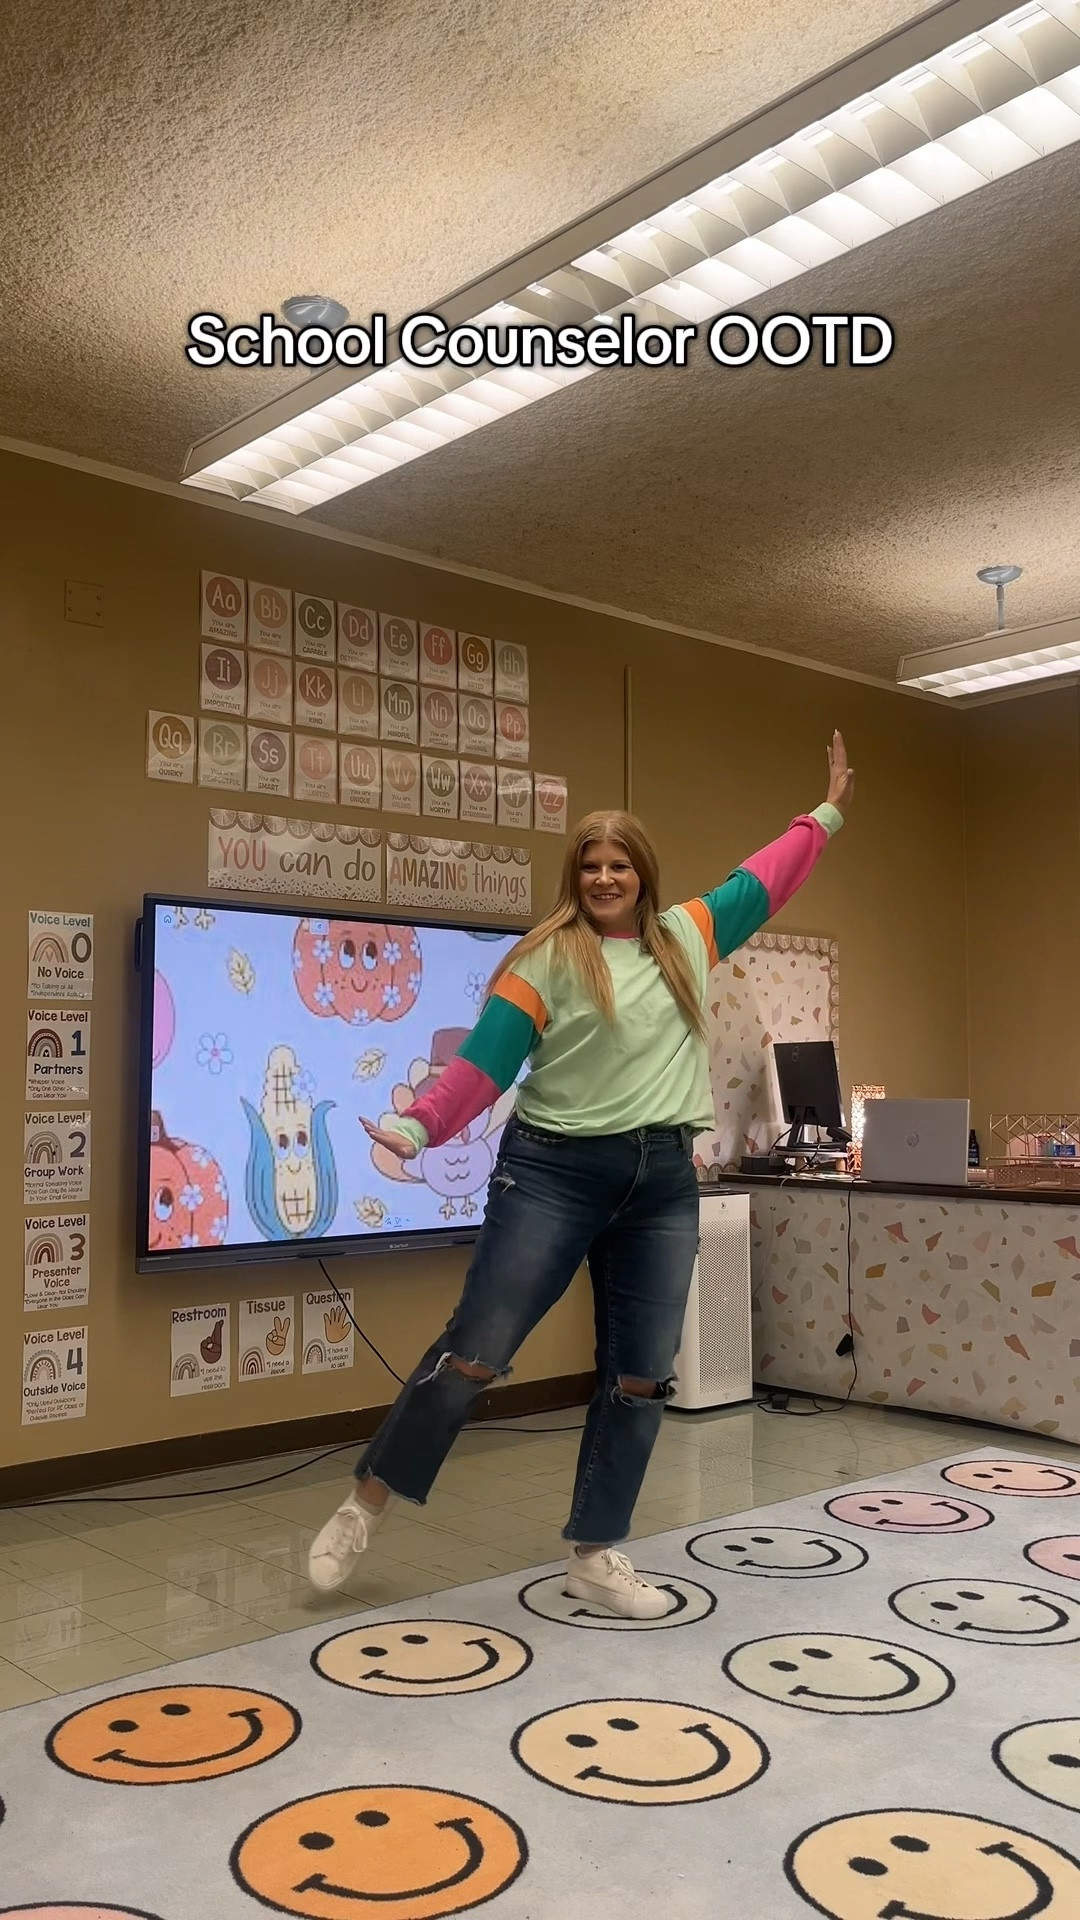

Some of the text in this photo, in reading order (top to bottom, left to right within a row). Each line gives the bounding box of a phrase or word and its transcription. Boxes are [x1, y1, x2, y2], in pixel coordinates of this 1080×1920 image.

[212, 584, 235, 611] Aa
[260, 595, 281, 621] Bb
[305, 605, 325, 630] Cc
[349, 615, 369, 641] Dd
[209, 627, 238, 637] AMAZING
[390, 625, 407, 649] Ee
[302, 647, 328, 657] CAPABLE
[431, 634, 445, 658] Ff
[467, 643, 483, 671] Gg
[216, 656, 231, 682] Ii
[503, 651, 520, 675] Hh
[261, 665, 279, 697] Jj
[306, 674, 326, 699] Kk
[205, 699, 240, 710] IMPORTANT
[387, 690, 410, 716] Mm
[430, 699, 448, 722] Nn
[308, 717, 323, 725] KIND
[468, 705, 484, 728] Oo
[506, 713, 520, 740] Pp
[158, 722, 184, 755] Qq
[212, 731, 234, 758] Rr
[259, 739, 279, 764] Ss
[306, 747, 324, 772] Tt
[159, 768, 184, 778] QUIRKY
[351, 755, 370, 779] Uu
[392, 761, 410, 785] Vv
[431, 766, 450, 792] Ww
[258, 782, 279, 791] SMART
[469, 772, 487, 796] Xx
[430, 806, 452, 815] WORTHY
[218, 835, 376, 882] YOU can do
[389, 856, 527, 903] AMAZING things
[30, 911, 90, 927] Voice Level
[71, 932, 92, 963] 0
[37, 966, 84, 979] No Voice
[28, 1009, 88, 1022] Voice Level
[71, 1030, 86, 1056] 1
[33, 1063, 84, 1075] Partners
[25, 1112, 85, 1124] Voice Level
[68, 1131, 86, 1158] 2
[24, 1165, 84, 1179] Group Work
[25, 1215, 86, 1230] Voice Level
[69, 1233, 86, 1261] 3
[32, 1266, 81, 1279] Presenter
[44, 1278, 70, 1288] Voice
[246, 1300, 286, 1314] Tissue
[306, 1290, 351, 1305] Question
[172, 1306, 227, 1324] Restroom
[24, 1328, 85, 1345] Voice Level
[66, 1347, 83, 1375] 4
[23, 1382, 86, 1397] Outside Voice
